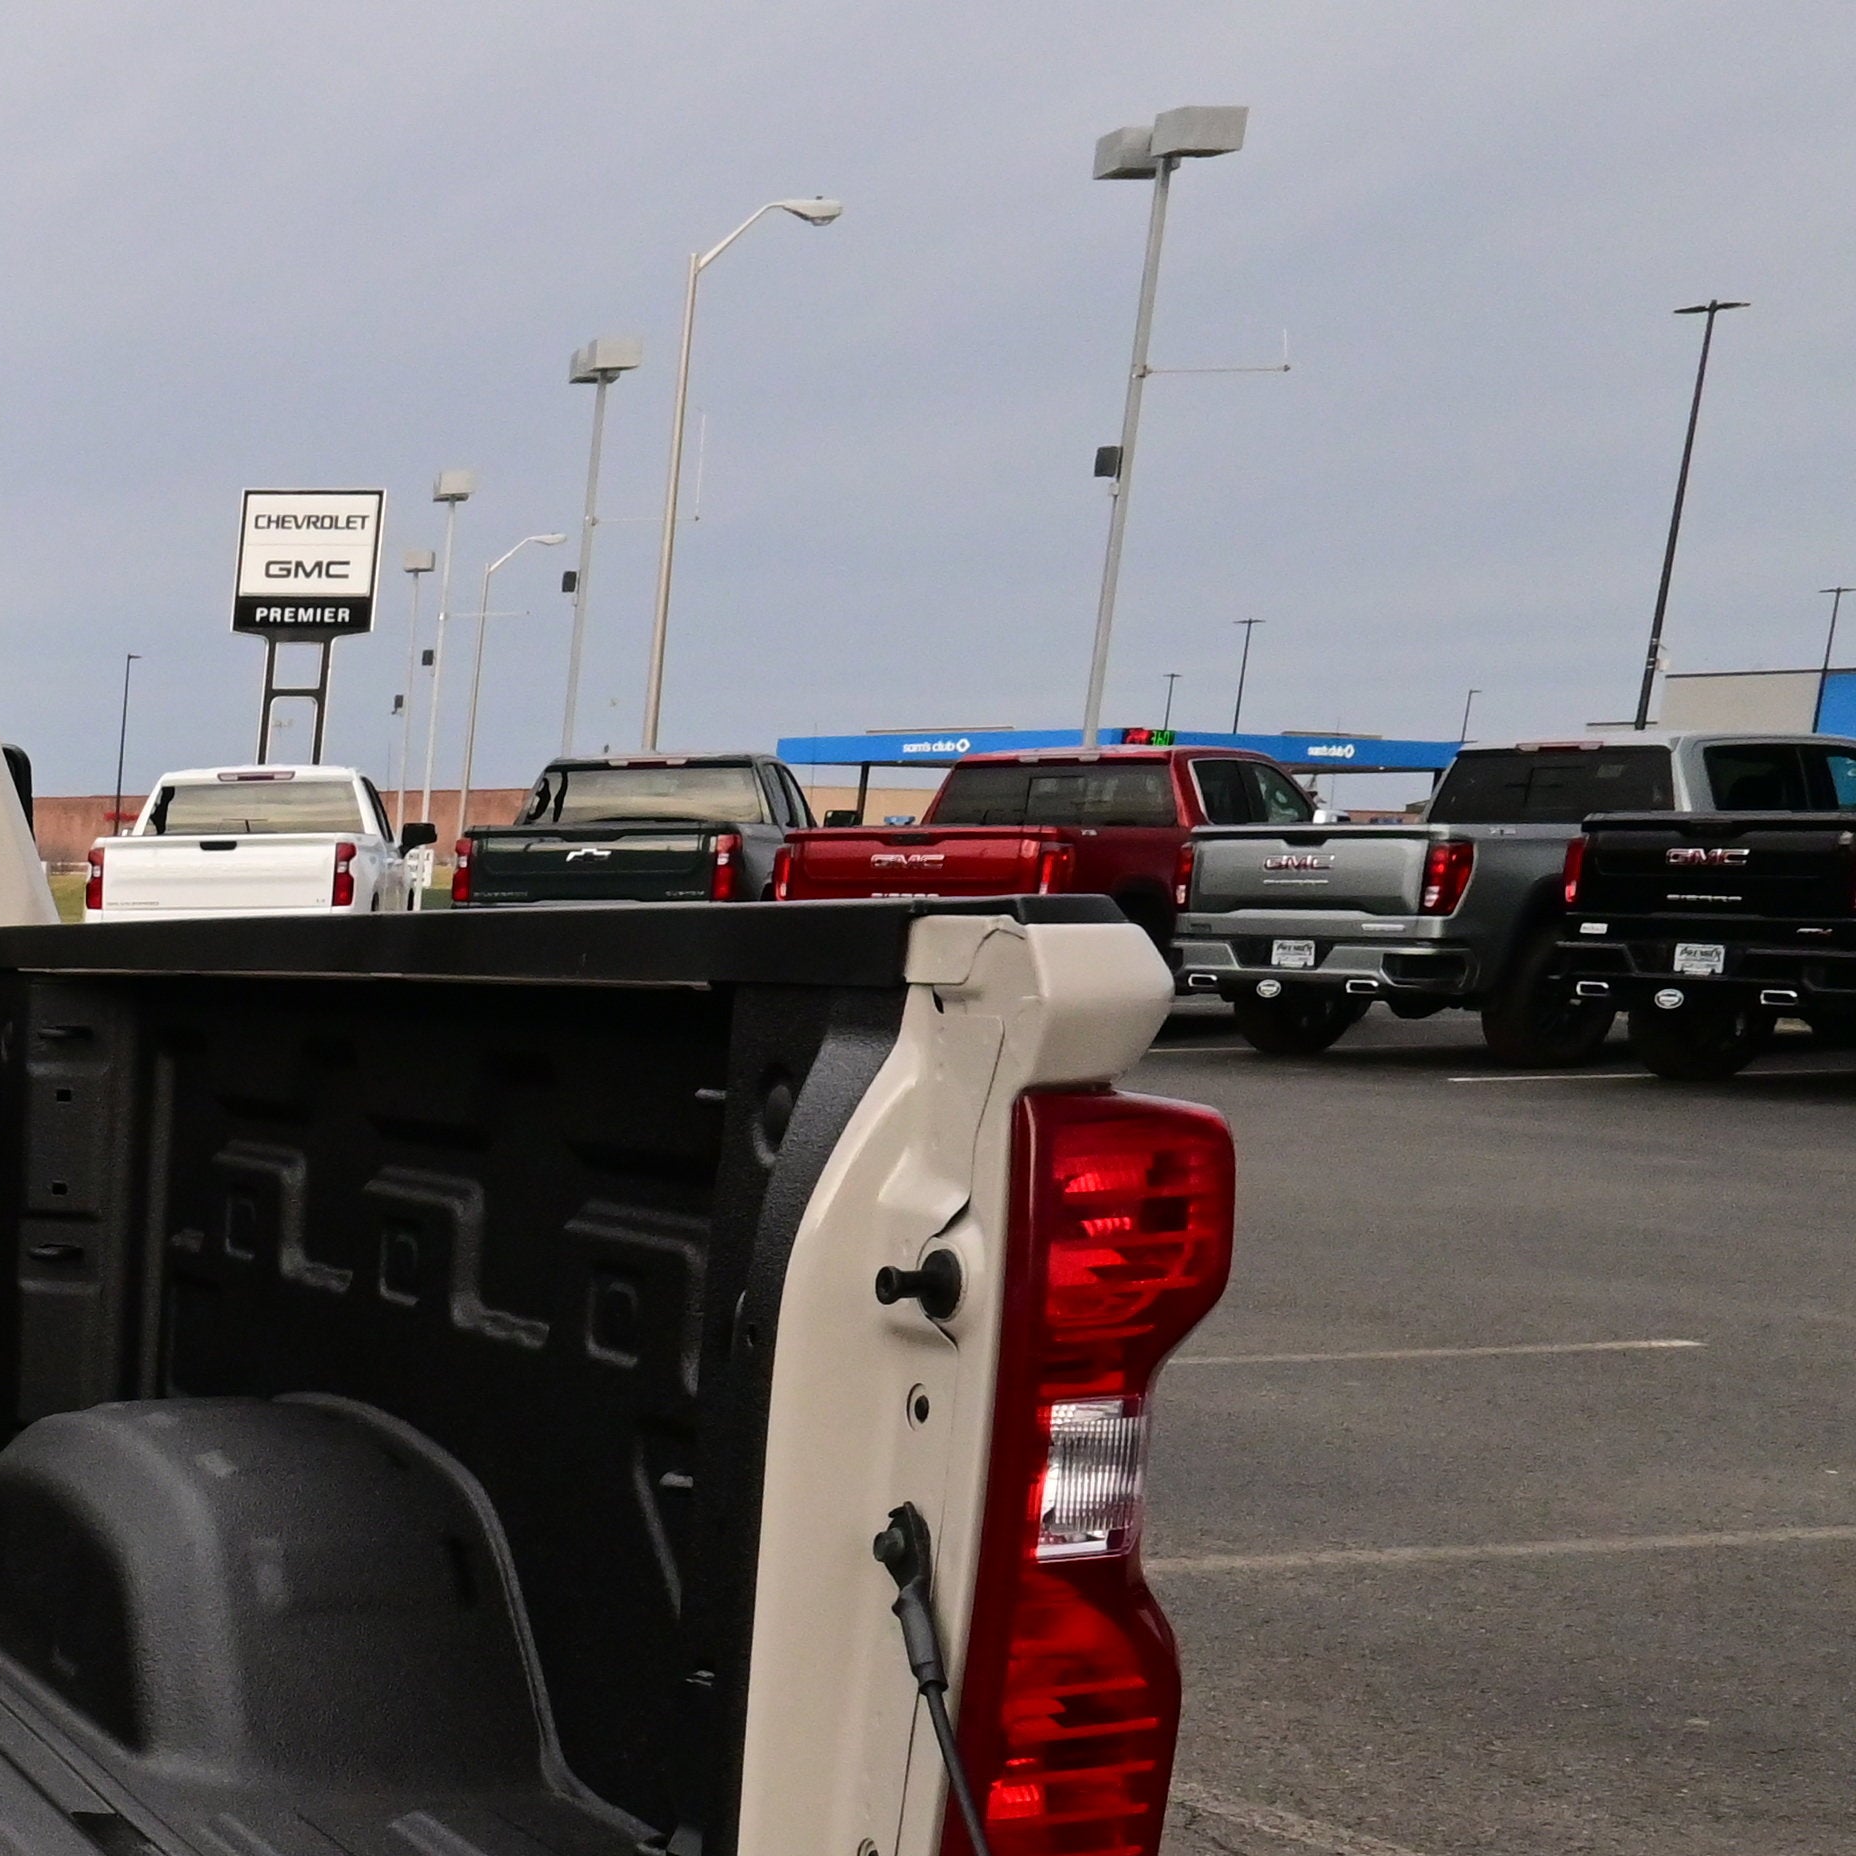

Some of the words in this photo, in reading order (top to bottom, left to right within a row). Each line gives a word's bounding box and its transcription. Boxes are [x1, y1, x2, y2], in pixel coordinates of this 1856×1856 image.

[254, 514, 369, 530] CHEVROLET
[265, 560, 350, 579] GMC
[255, 607, 350, 623] PREMIER
[932, 740, 955, 752] club
[871, 854, 944, 869] GMC
[1264, 855, 1335, 871] GMC
[1666, 848, 1750, 865] GMC
